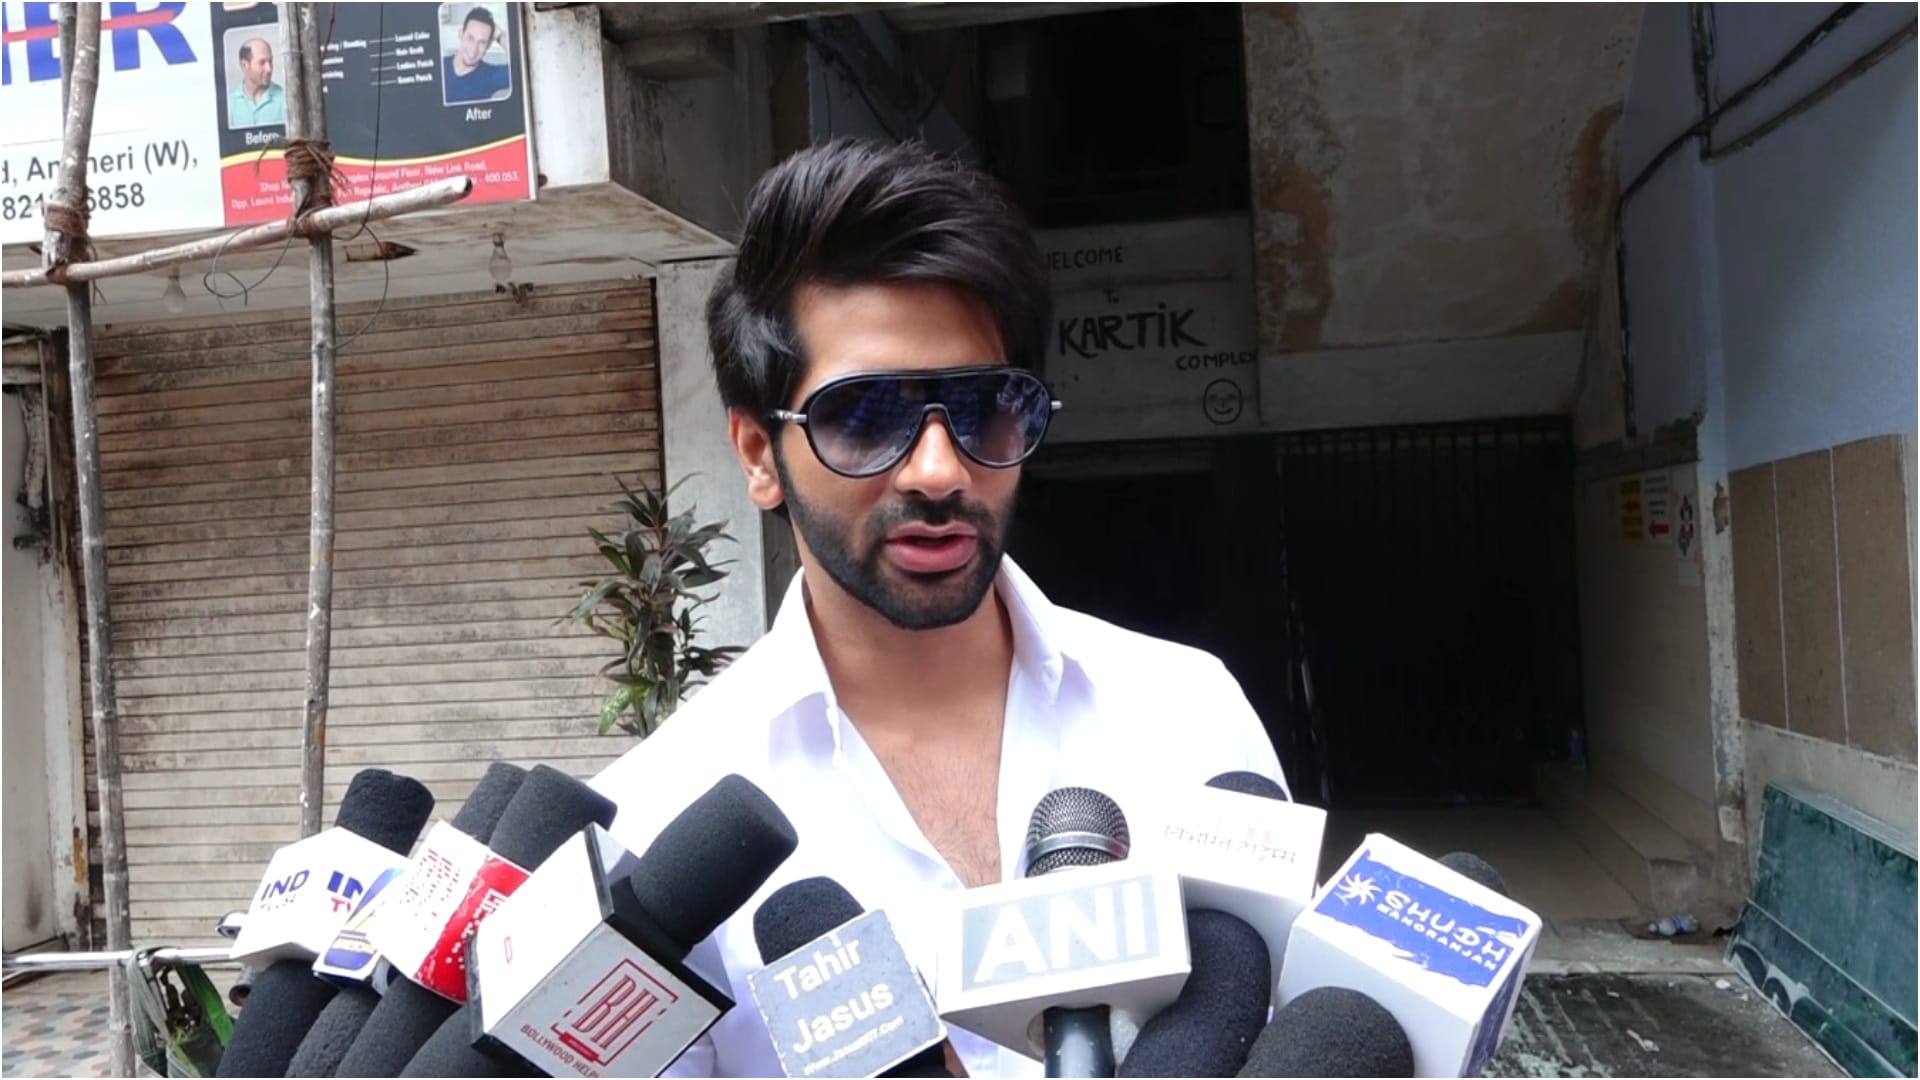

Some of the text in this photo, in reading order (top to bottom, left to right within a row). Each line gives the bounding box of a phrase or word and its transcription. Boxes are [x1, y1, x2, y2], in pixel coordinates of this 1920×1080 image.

[464, 107, 493, 122] After
[144, 139, 199, 175] (W),
[1046, 246, 1124, 271] ELCOME
[973, 881, 1147, 984] ANI
[772, 928, 862, 1000] Tahir
[792, 980, 894, 1055] Jasus
